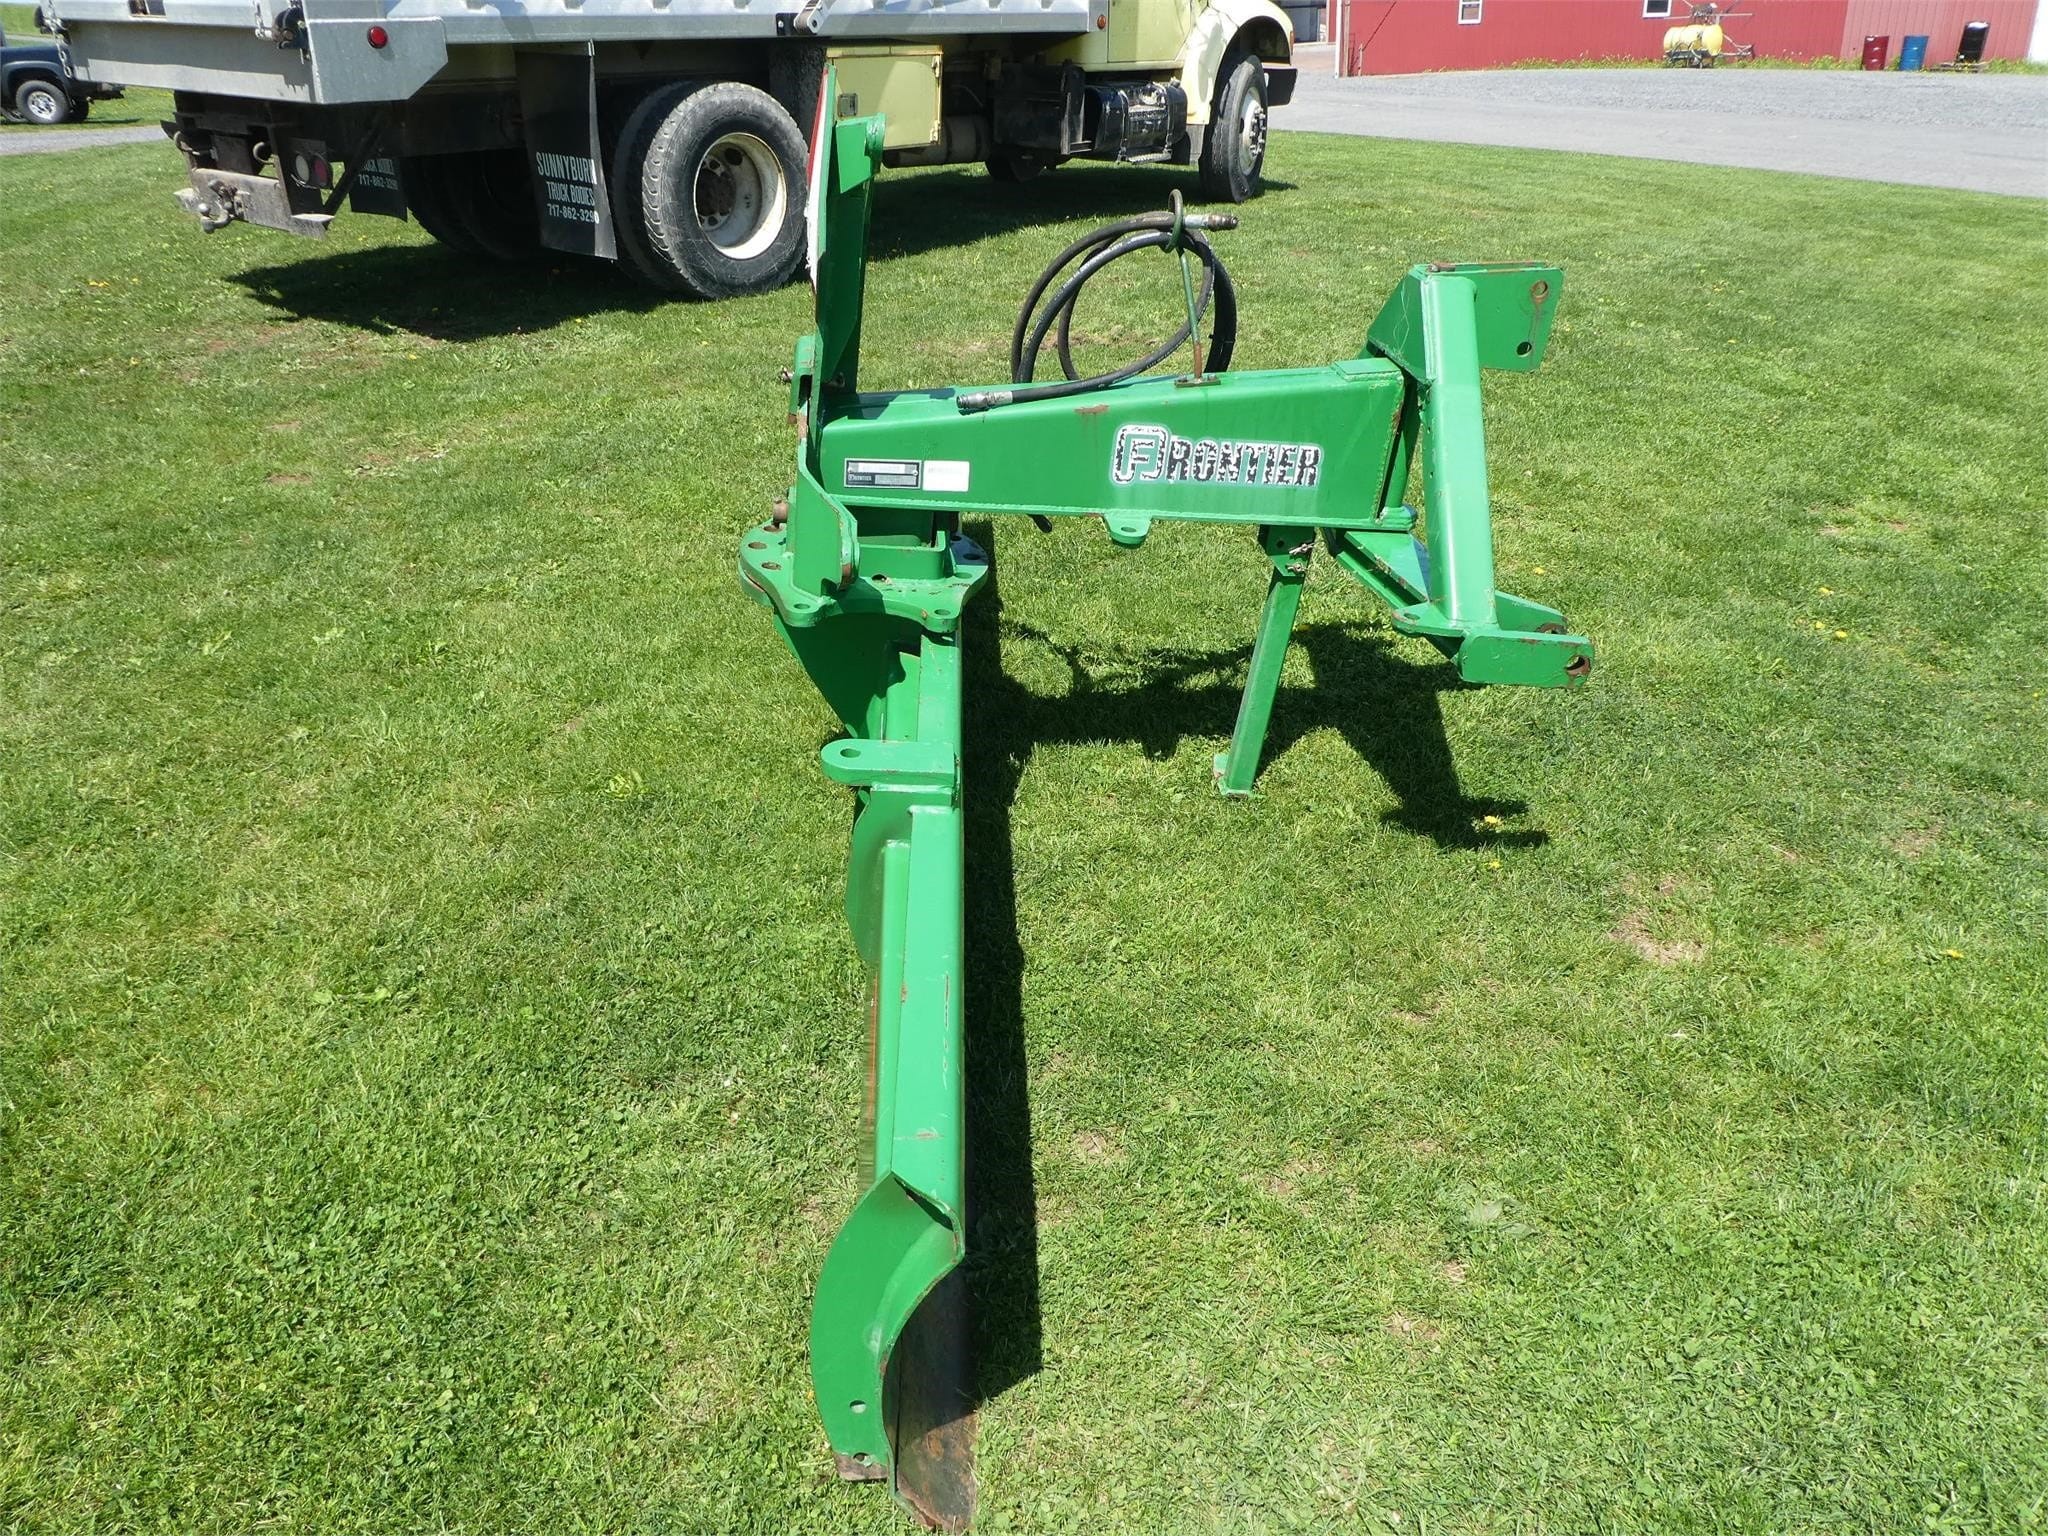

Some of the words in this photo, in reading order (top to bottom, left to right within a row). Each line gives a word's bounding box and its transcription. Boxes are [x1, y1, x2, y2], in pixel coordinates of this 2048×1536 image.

[536, 151, 597, 184] SUNNYBURN
[546, 181, 570, 203] TRUCK
[570, 184, 595, 206] BODIES
[546, 203, 600, 224] 717-862-3290
[1111, 424, 1324, 486] FRONTIER
